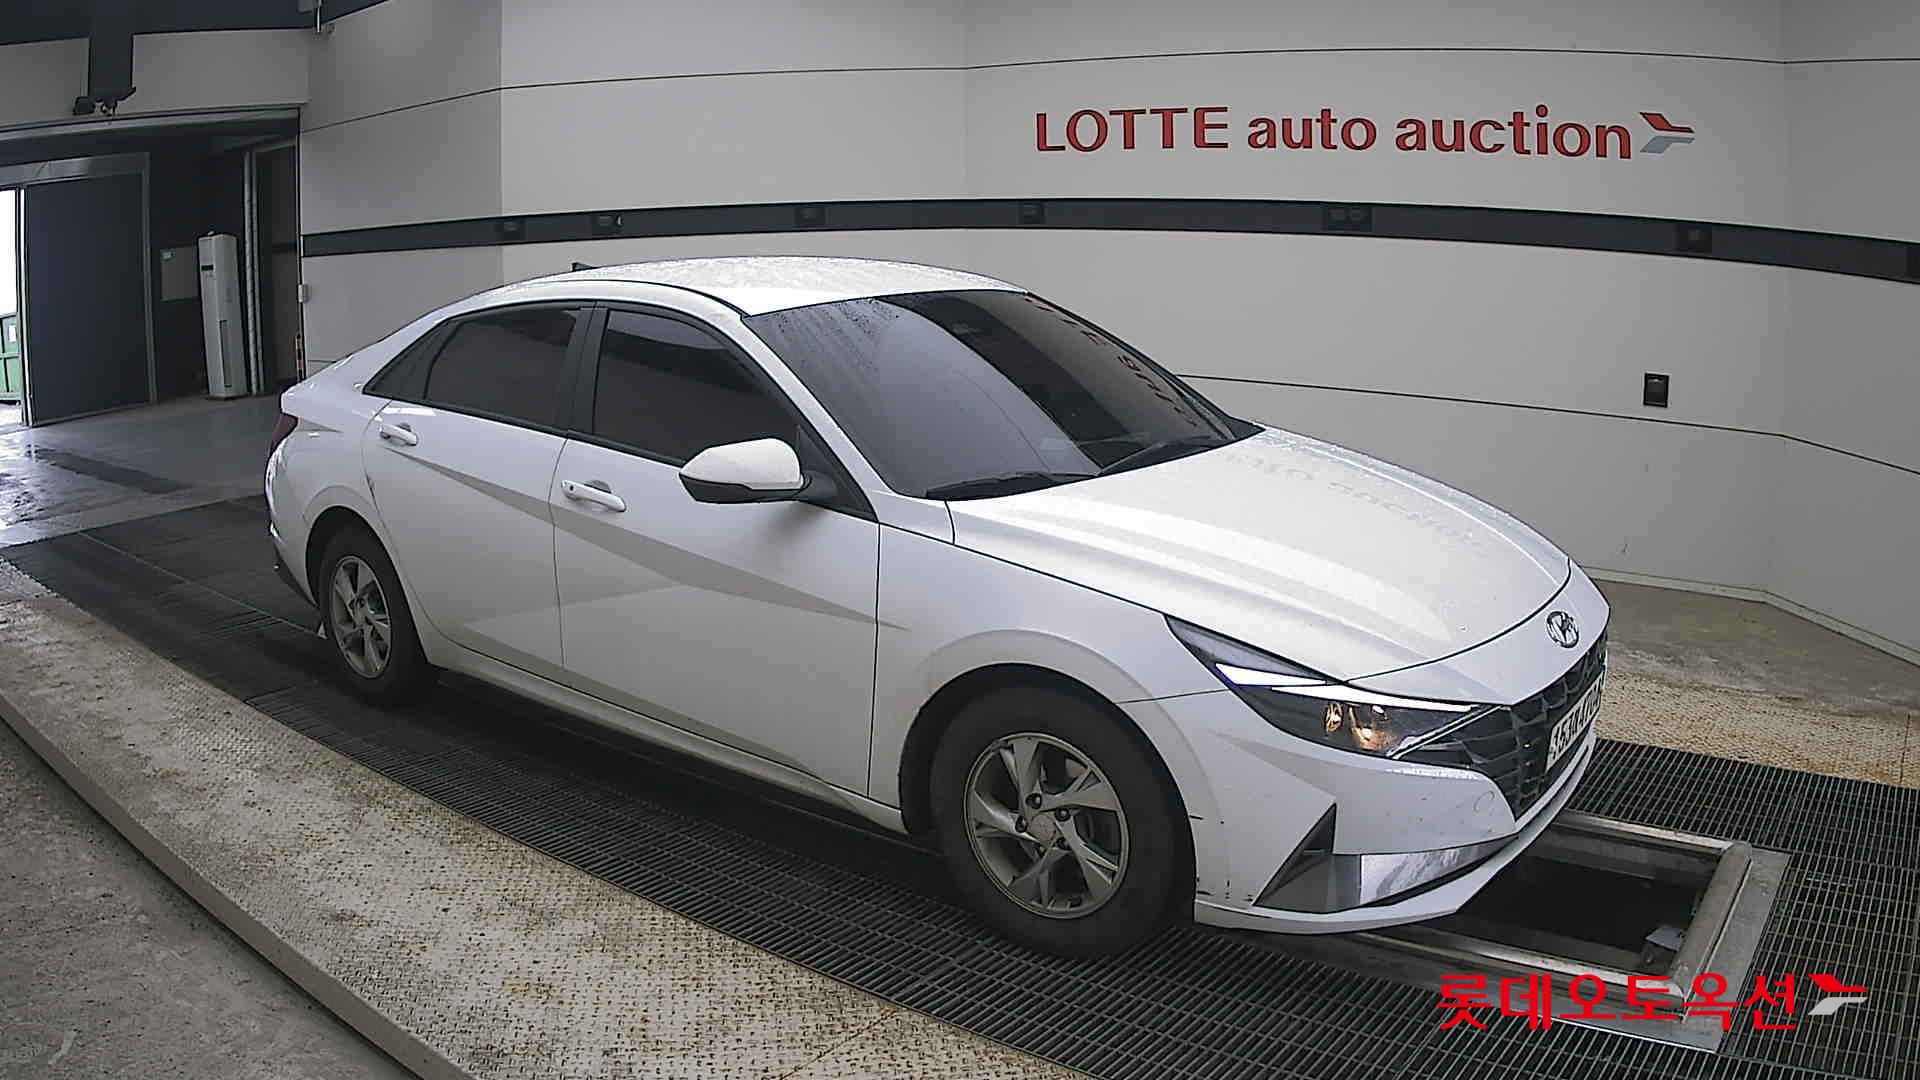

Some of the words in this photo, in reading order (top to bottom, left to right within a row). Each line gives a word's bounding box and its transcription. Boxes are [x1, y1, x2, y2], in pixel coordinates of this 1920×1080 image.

[1035, 105, 1229, 153] LOTTE
[1247, 107, 1377, 151] auto
[1394, 104, 1633, 160] auction
